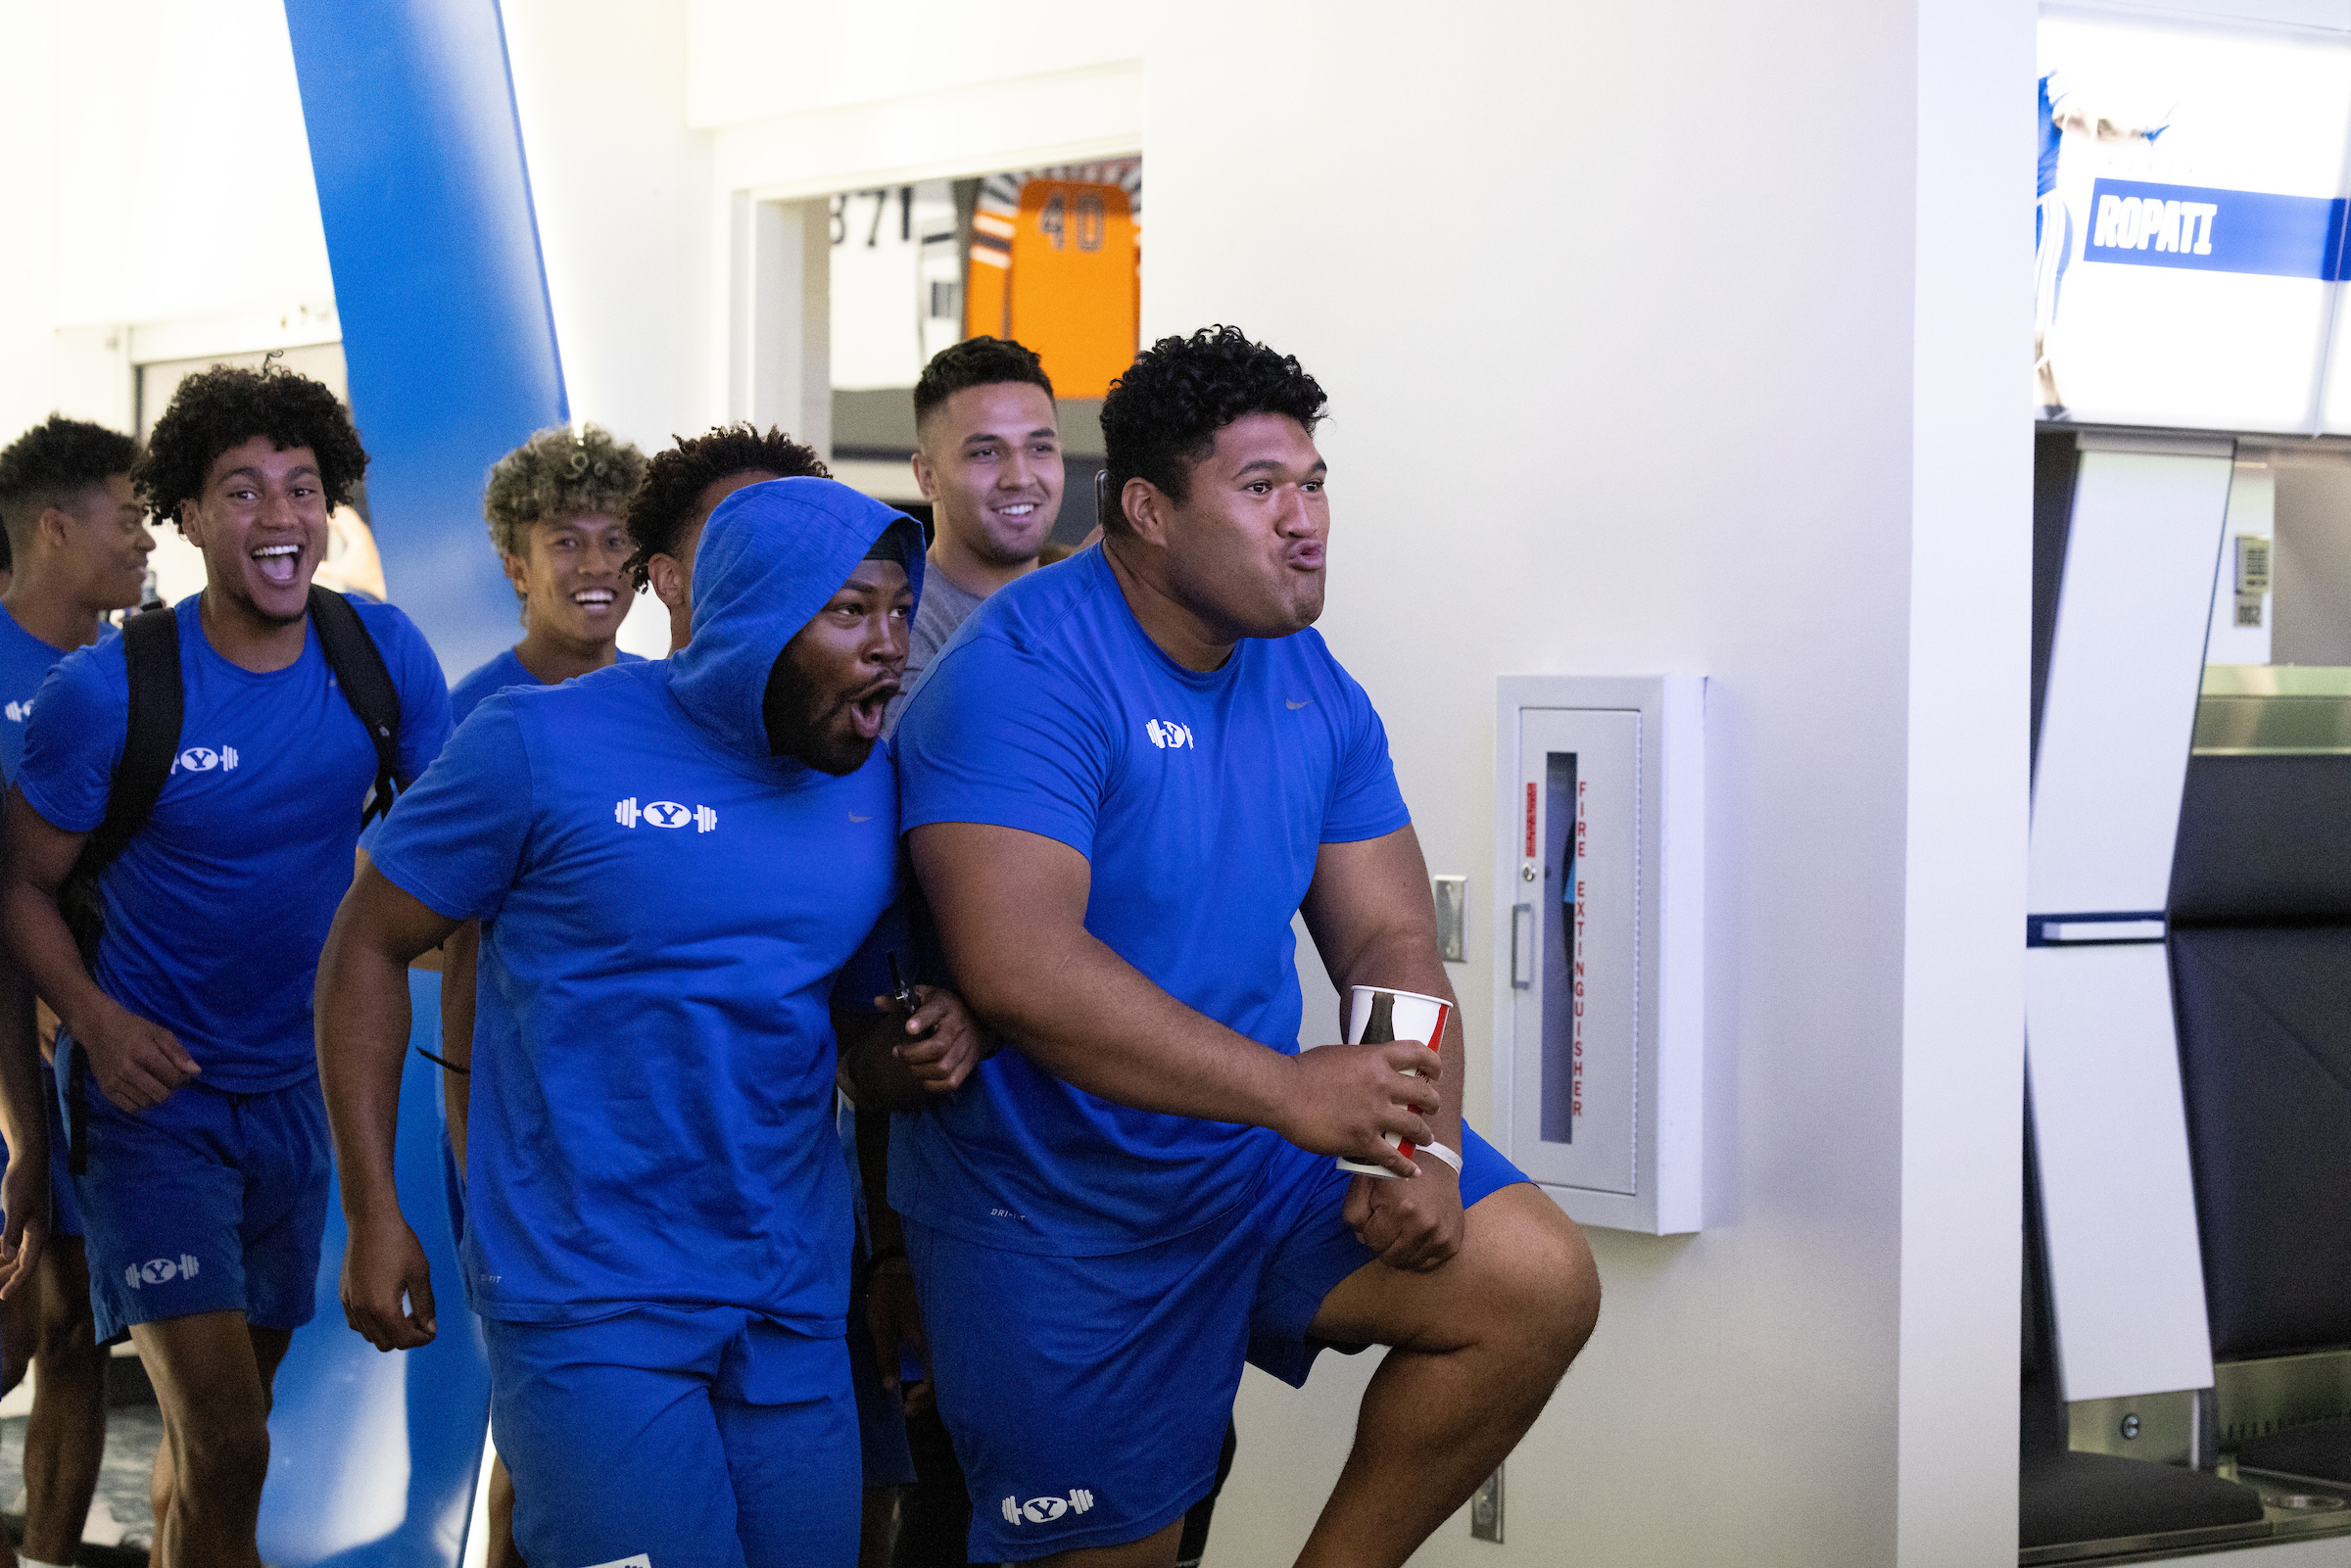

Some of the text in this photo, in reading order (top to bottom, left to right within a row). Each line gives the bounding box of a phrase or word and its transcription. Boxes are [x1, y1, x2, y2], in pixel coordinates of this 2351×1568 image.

[1039, 194, 1105, 253] 40
[2093, 194, 2218, 255] ROPATI
[650, 803, 684, 826] Y
[1572, 782, 1587, 1117] FIRE EXTINGUISHER
[1028, 1499, 1058, 1520] Y
